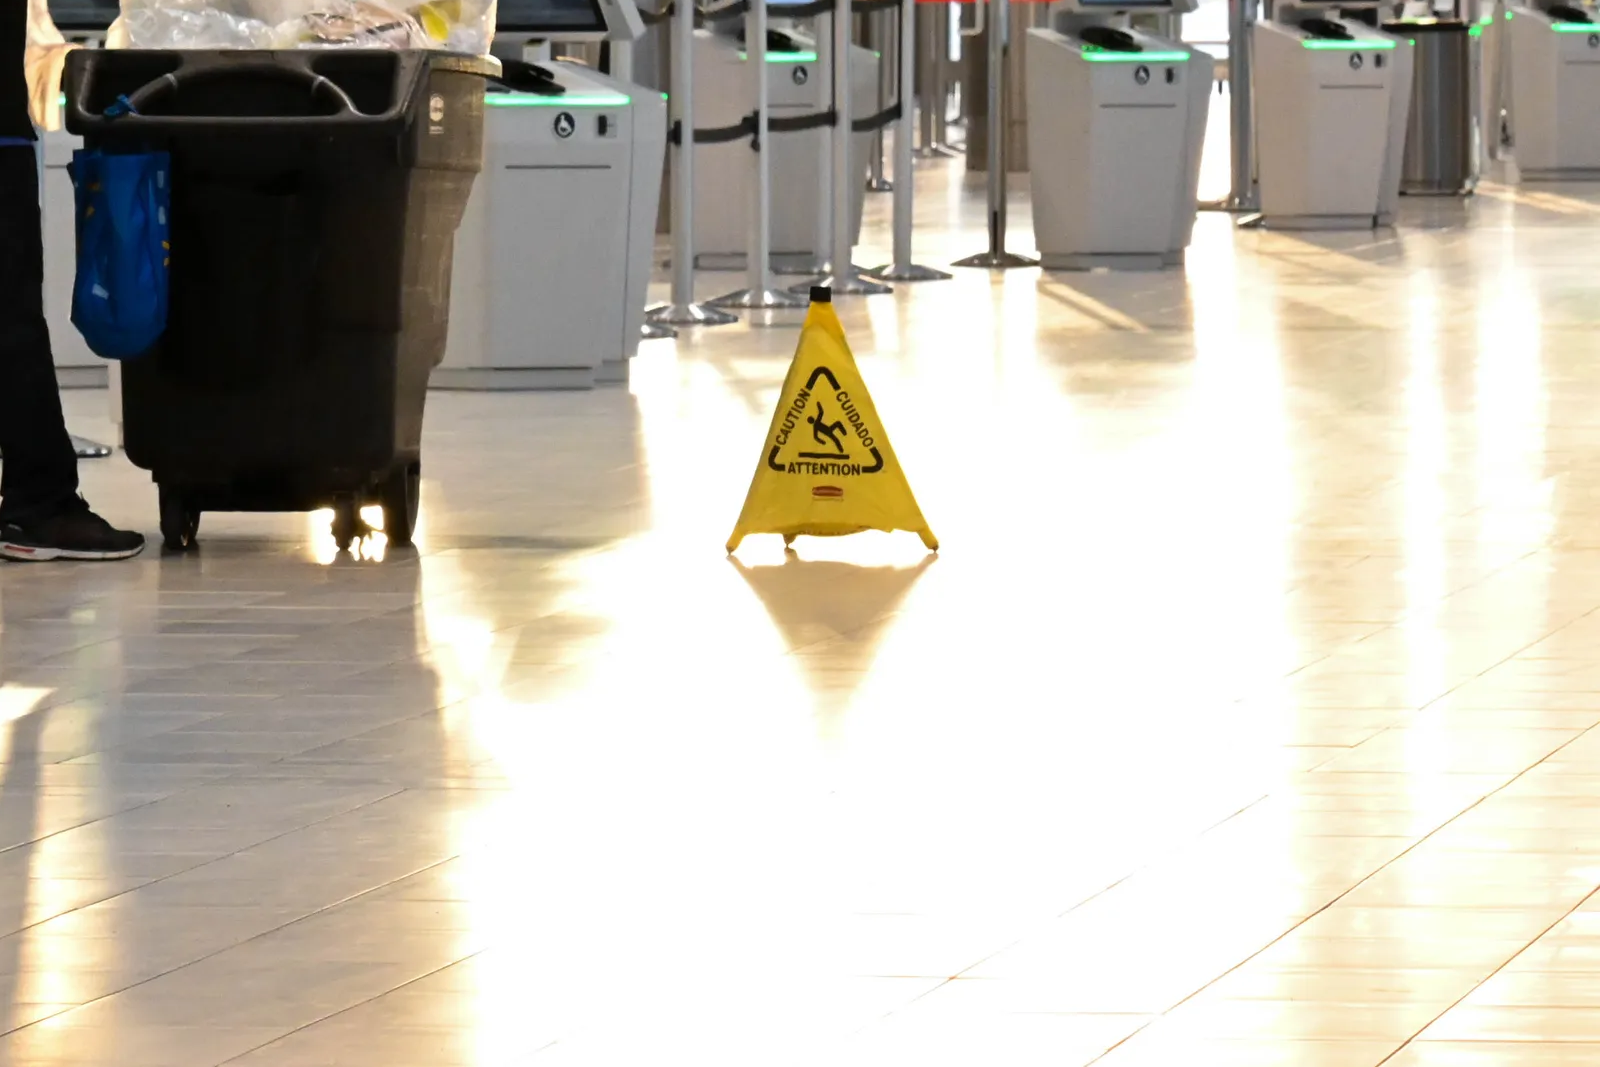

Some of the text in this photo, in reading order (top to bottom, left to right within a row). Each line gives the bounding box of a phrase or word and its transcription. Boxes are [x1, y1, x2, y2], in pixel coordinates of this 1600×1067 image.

[775, 388, 811, 446] CAUTION
[836, 391, 874, 448] CUIDADO
[787, 462, 861, 476] ATTENTION
